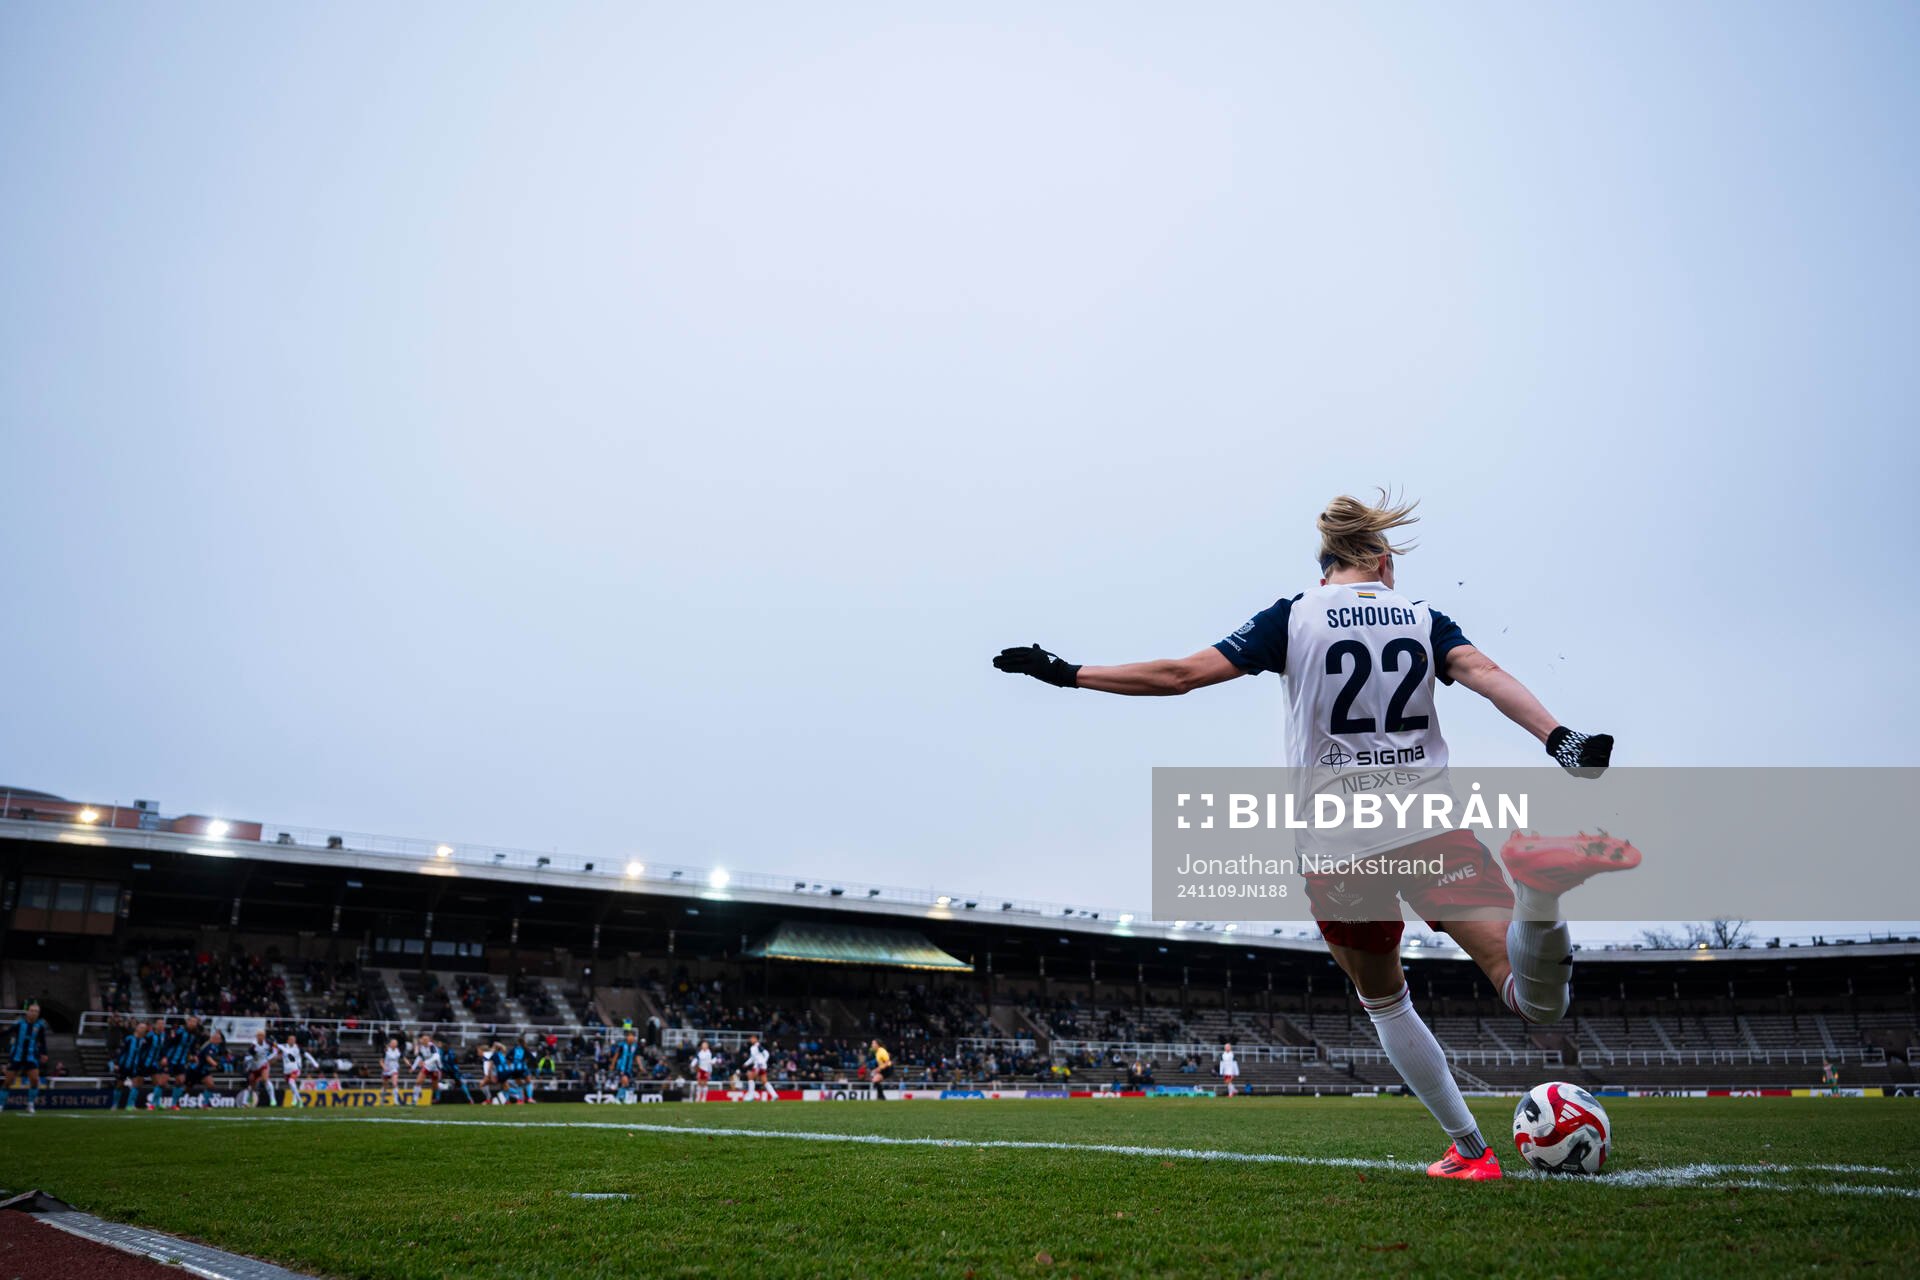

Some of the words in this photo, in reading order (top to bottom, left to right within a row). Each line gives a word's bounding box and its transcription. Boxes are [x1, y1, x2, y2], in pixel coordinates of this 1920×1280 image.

[1326, 606, 1417, 629] SCHOUGH
[1325, 637, 1429, 736] 22
[146, 1092, 236, 1108] Sudstöm
